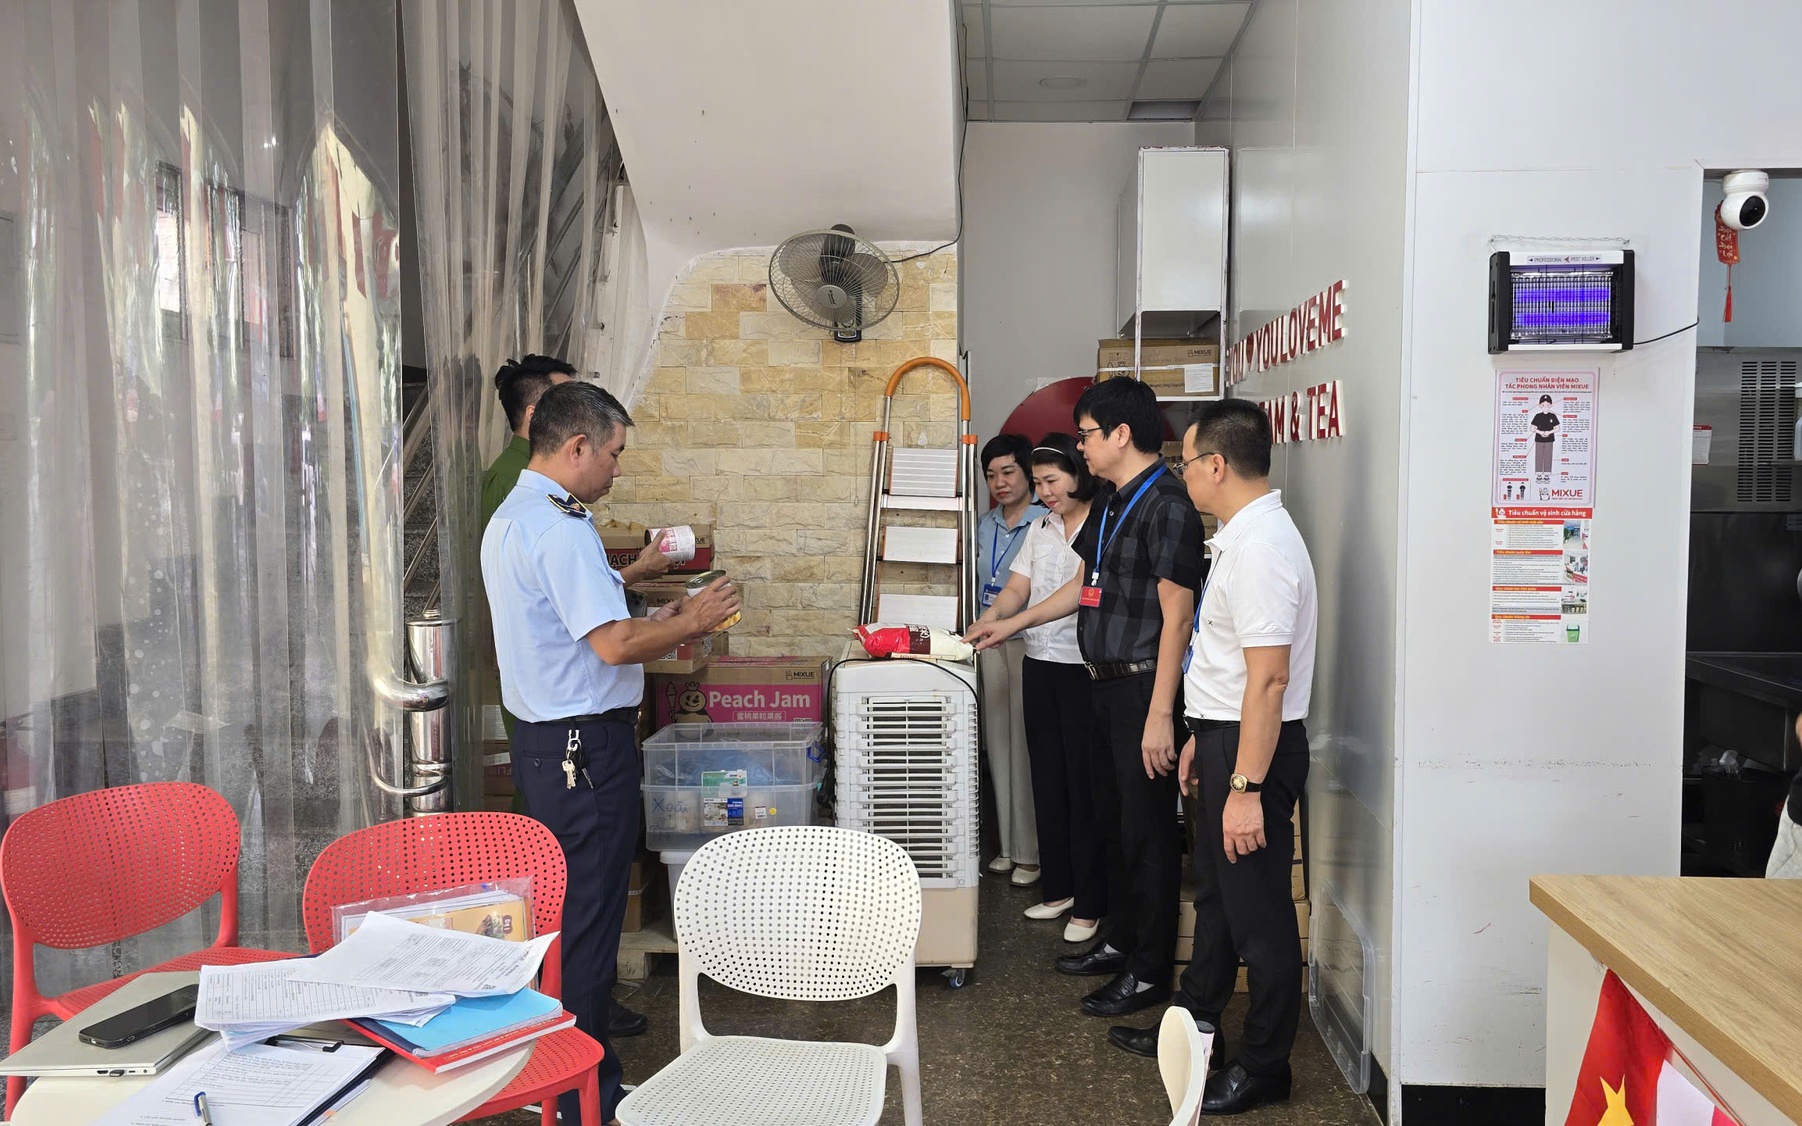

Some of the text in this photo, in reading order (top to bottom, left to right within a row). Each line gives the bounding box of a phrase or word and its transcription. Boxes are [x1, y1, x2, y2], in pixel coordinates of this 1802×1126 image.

[1290, 391, 1302, 442] &
[1307, 380, 1344, 440] TEA
[1551, 489, 1583, 497] MIXUE
[1571, 509, 1587, 517] hàng
[709, 689, 810, 708] Peach Jam
